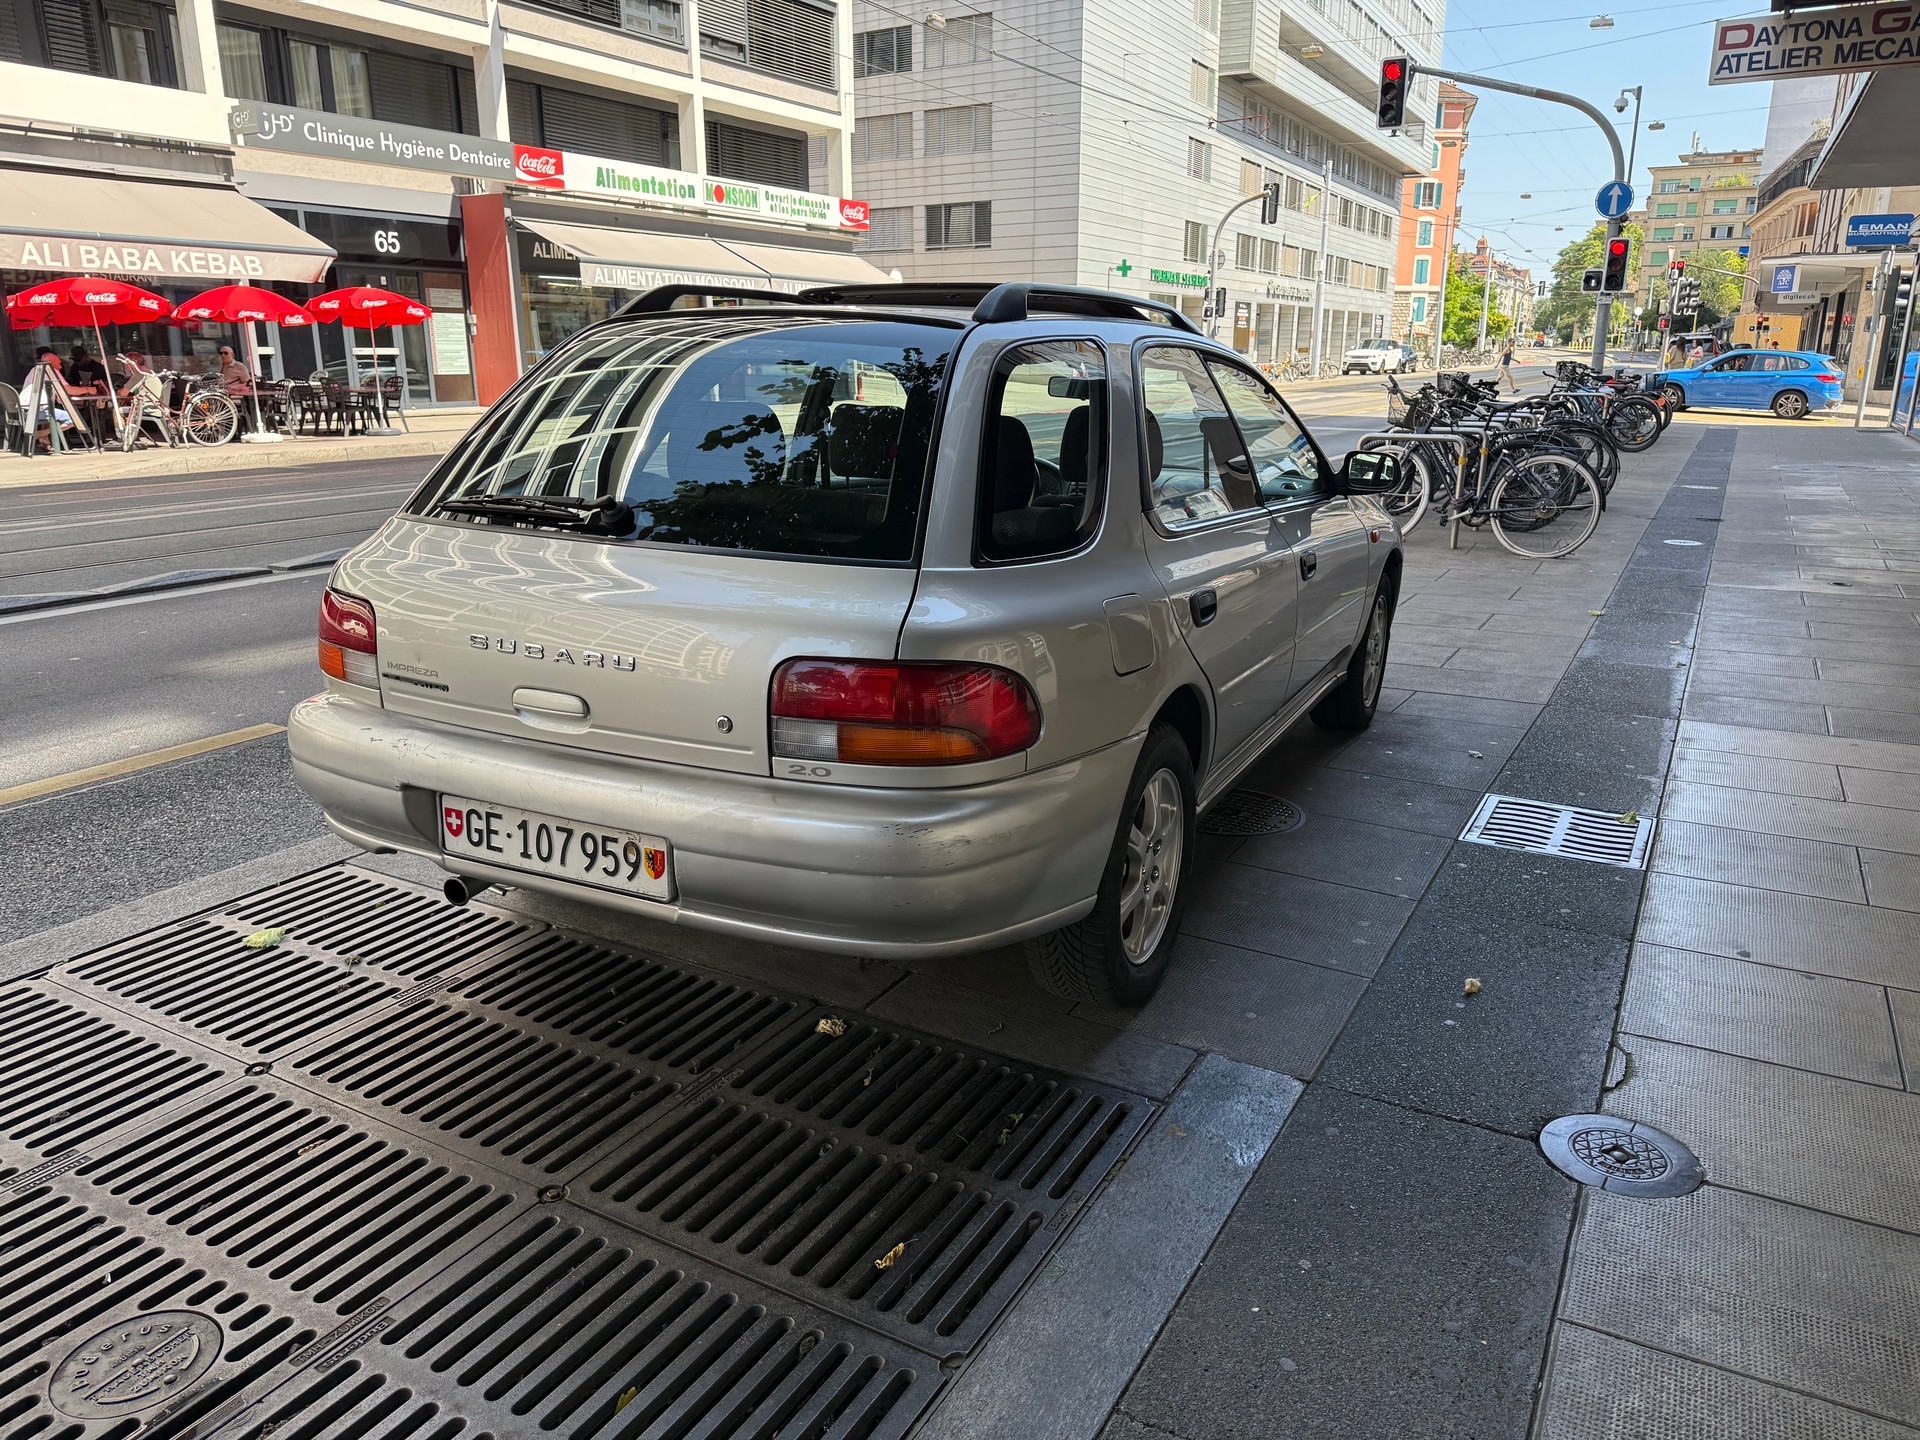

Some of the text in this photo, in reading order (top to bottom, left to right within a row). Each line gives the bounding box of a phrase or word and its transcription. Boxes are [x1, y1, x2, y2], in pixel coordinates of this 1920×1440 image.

[1718, 16, 1863, 50] DAYTONA
[1715, 36, 1920, 75] ATELIER MECA
[304, 121, 374, 151] Clinique
[380, 131, 444, 159] Hygiène
[450, 143, 511, 169] Dentaire
[519, 153, 557, 175] Coca-Cola
[596, 166, 696, 199] Alimentation
[765, 190, 789, 204] Ouvert
[798, 196, 830, 210] dimanche
[374, 230, 401, 254] 65
[1848, 223, 1909, 233] LEMAN
[20, 241, 264, 276] ALI BABA KEBAB
[533, 241, 577, 261] ALIME
[85, 292, 117, 303] Coca-Cola
[469, 633, 636, 672] SUBARU
[387, 661, 439, 678] IMPREZA
[788, 764, 832, 777] 2.0
[295, 1343, 323, 1363] TMH
[333, 1302, 384, 1339] ZUMIKON
[322, 1320, 389, 1369] Buderus
